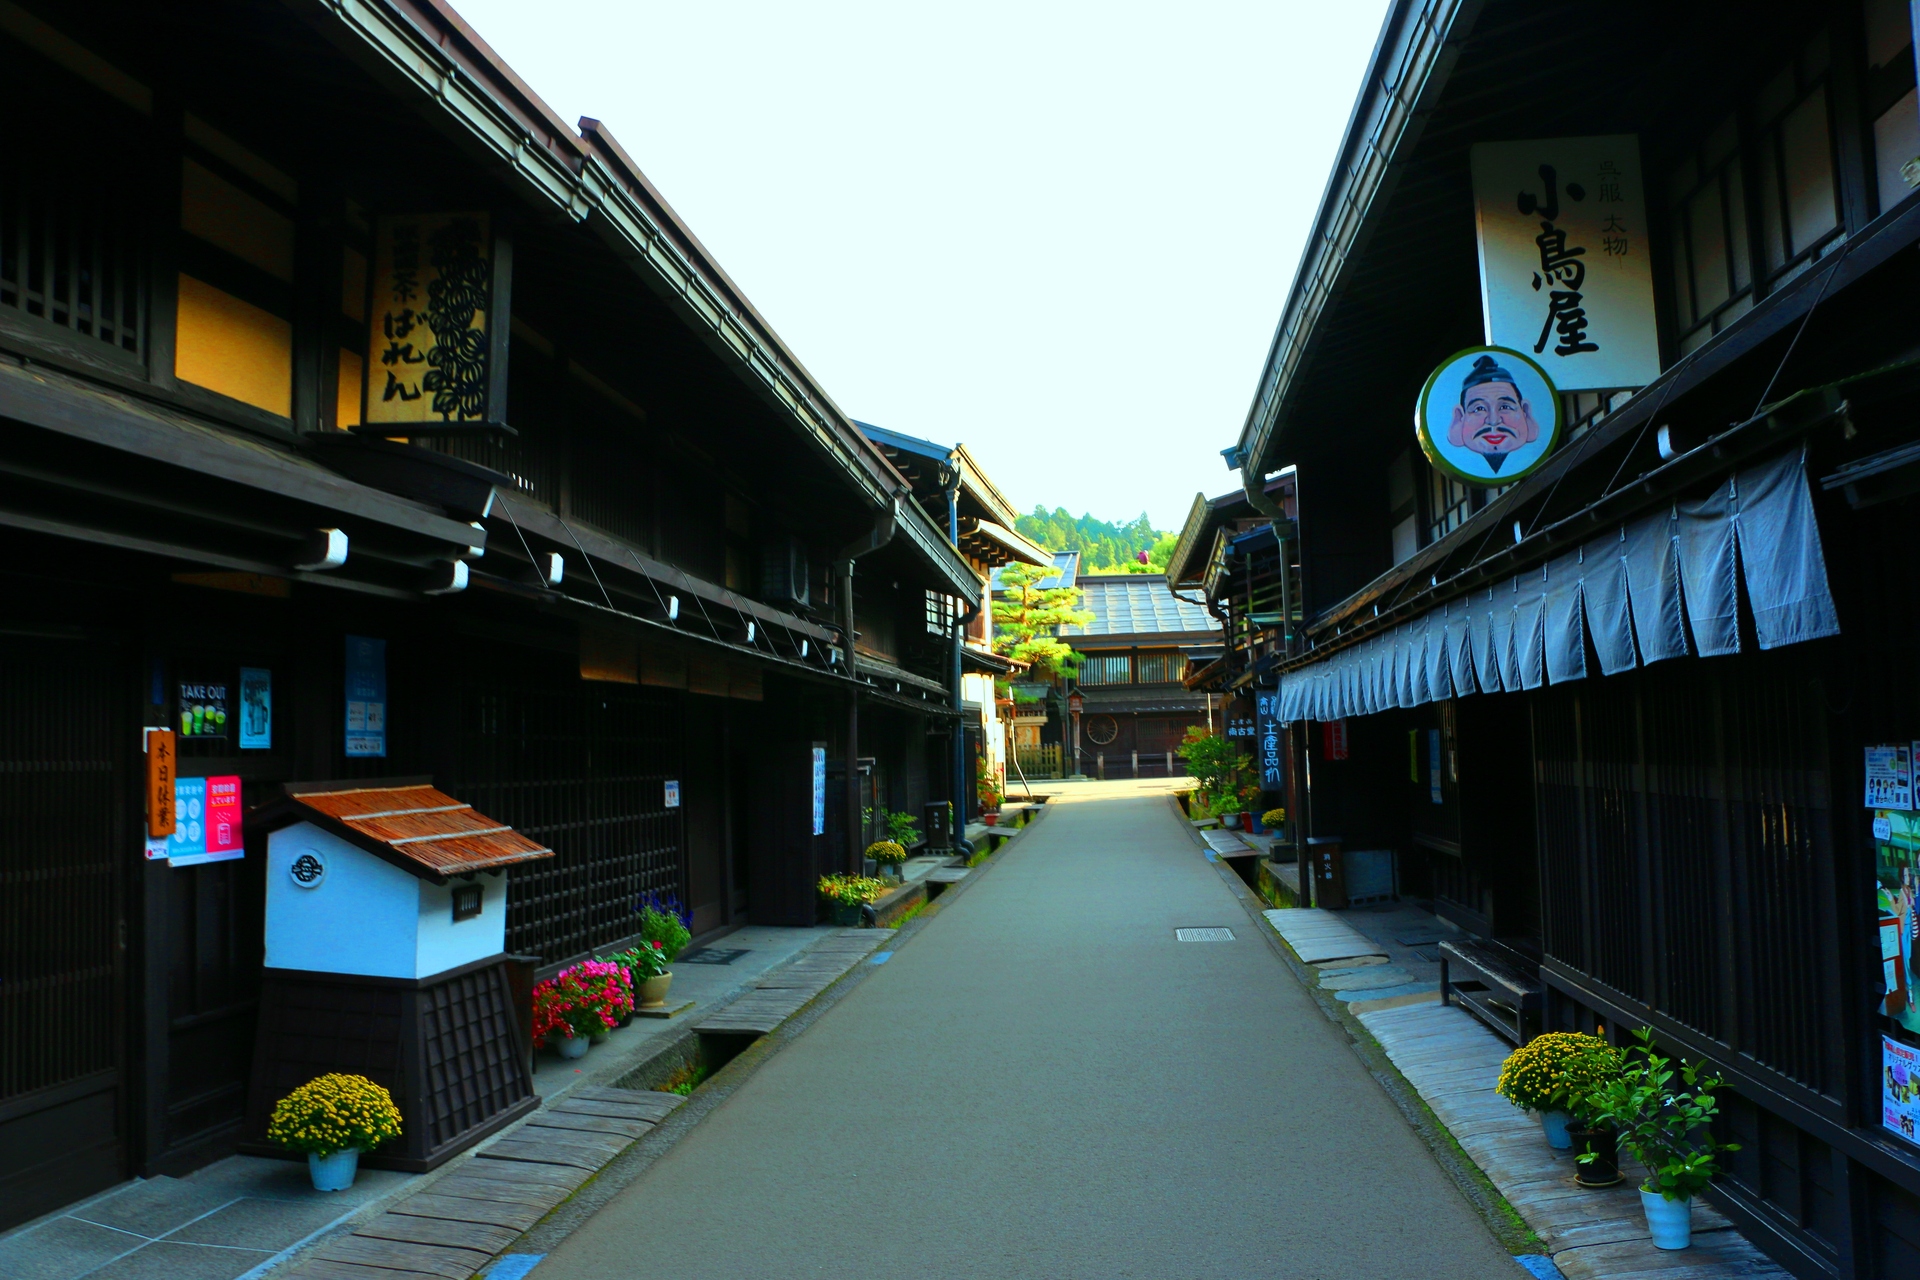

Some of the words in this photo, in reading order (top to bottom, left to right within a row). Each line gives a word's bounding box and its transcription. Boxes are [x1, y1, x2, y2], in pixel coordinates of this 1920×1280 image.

[1597, 160, 1624, 203] 呉服
[1517, 164, 1599, 357] 小鳥屋
[1602, 213, 1628, 257] 太物
[381, 309, 428, 402] ばれん
[180, 684, 206, 699] TAKE
[207, 685, 227, 700] OUT
[156, 741, 171, 828] 本日休業
